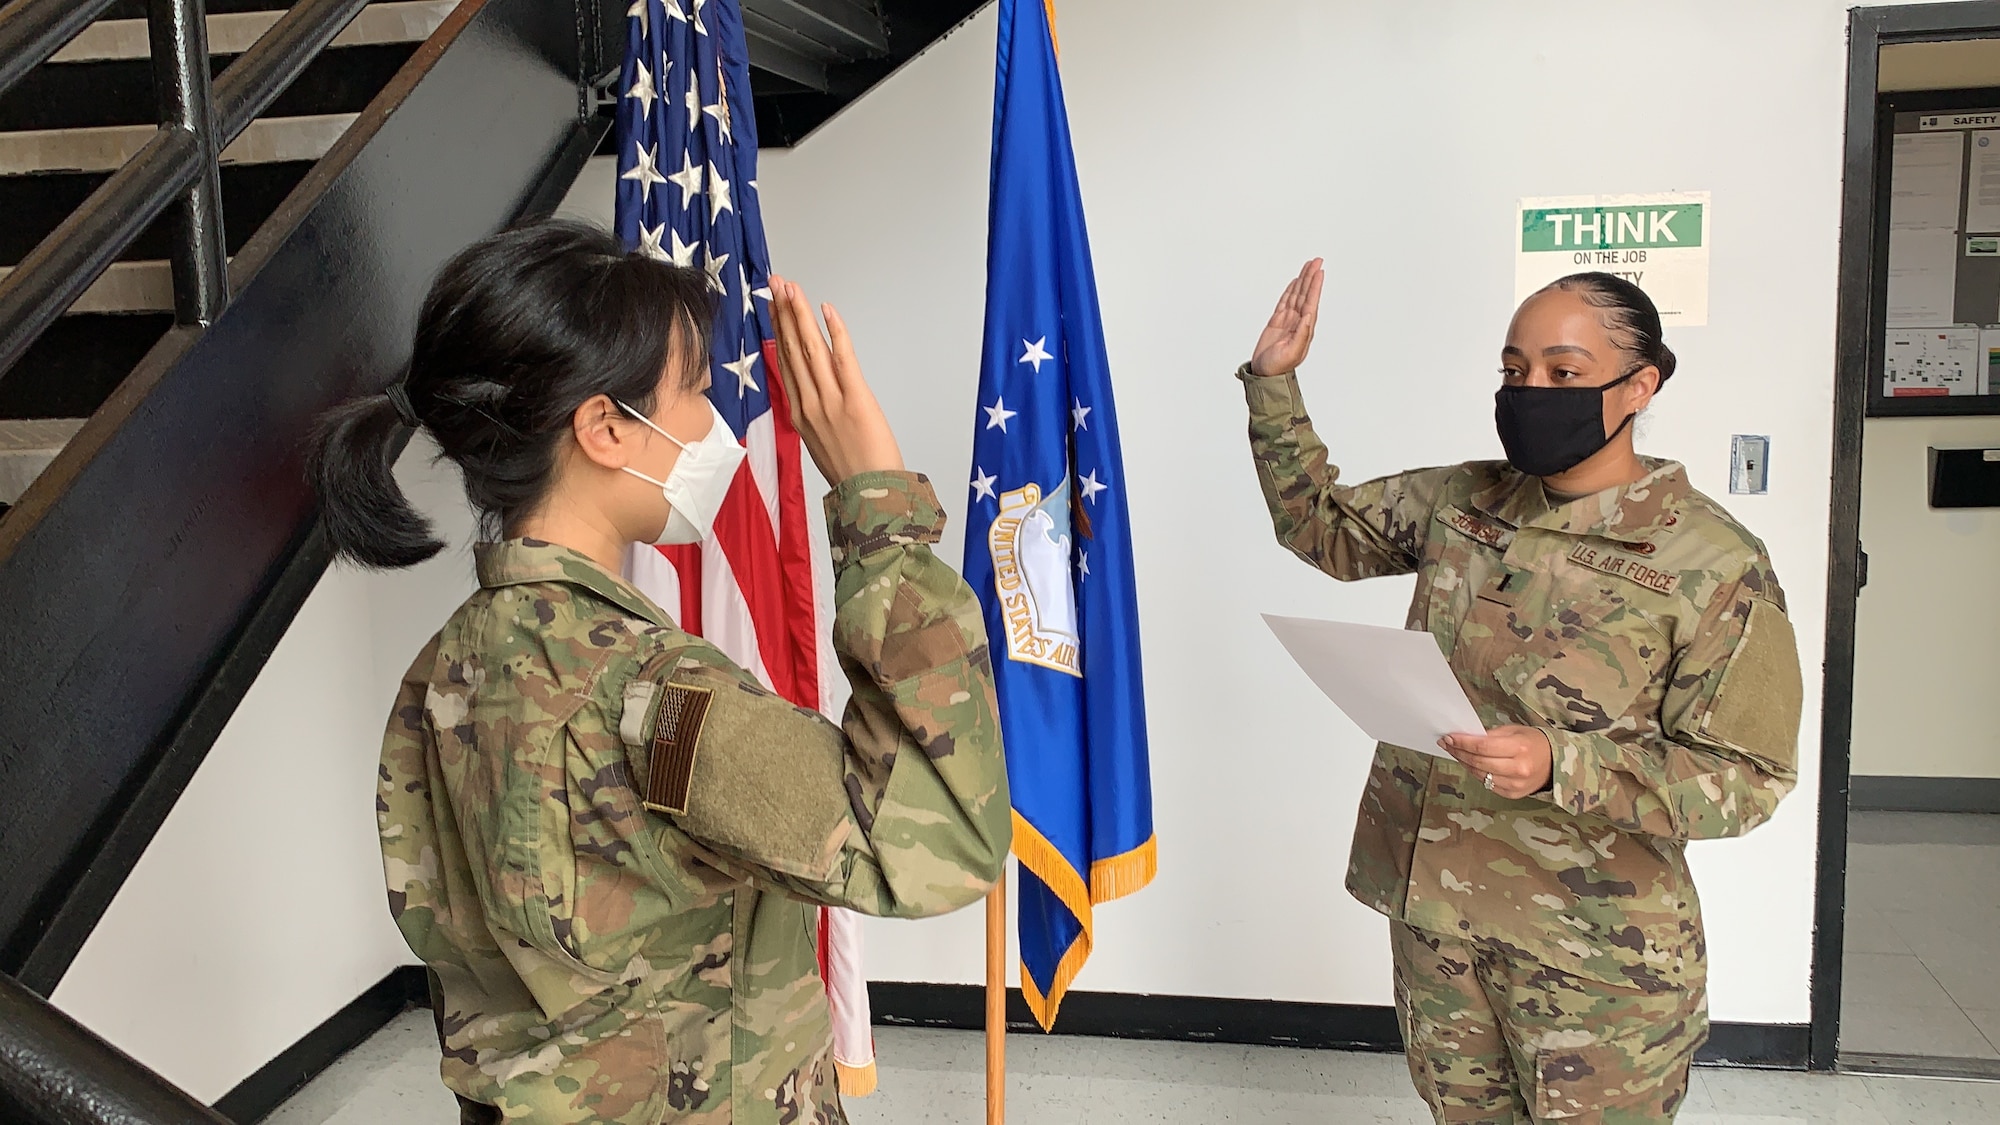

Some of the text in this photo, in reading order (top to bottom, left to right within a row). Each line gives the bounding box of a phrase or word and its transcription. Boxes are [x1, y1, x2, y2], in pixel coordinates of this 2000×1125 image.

[1953, 115, 1997, 125] SAFETY
[1545, 210, 1679, 246] THINK
[1573, 250, 1647, 265] ON THE JOB
[1598, 555, 1625, 573] AIR
[1625, 561, 1677, 591] FORCE
[994, 517, 1076, 667] UNITED STATES AIR
